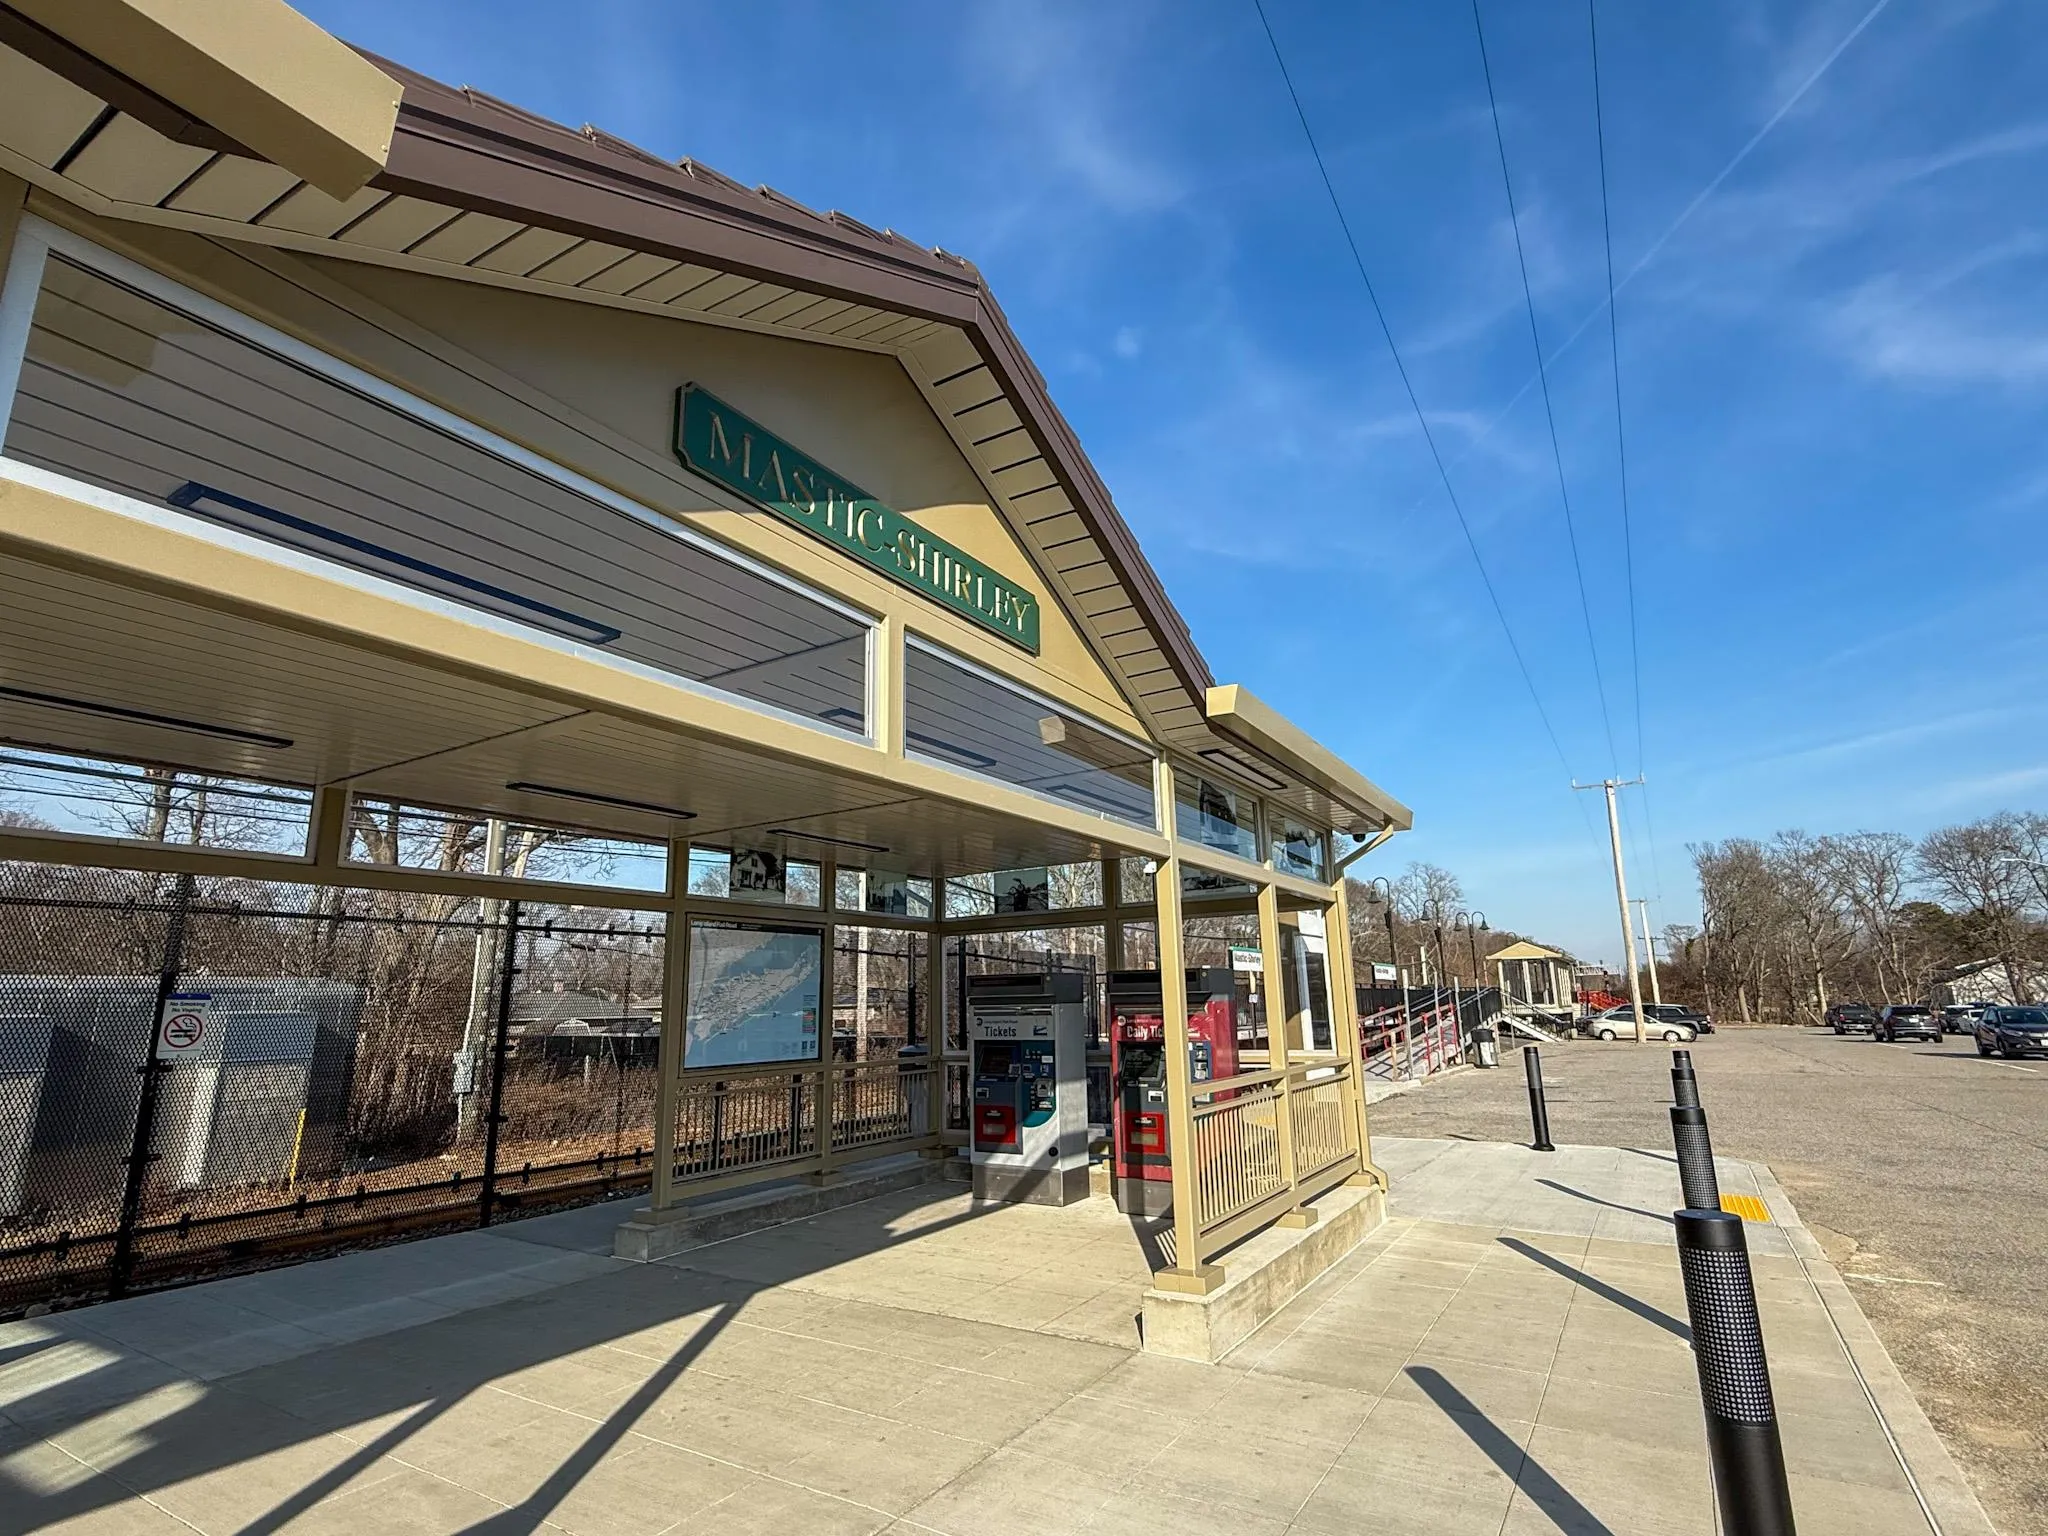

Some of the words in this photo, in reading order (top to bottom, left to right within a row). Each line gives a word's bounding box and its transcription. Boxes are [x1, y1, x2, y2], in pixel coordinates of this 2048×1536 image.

[707, 410, 1032, 634] MASTIC-SHIRLEY
[984, 1025, 1017, 1037] Tickets
[1126, 1025, 1149, 1041] Daily
